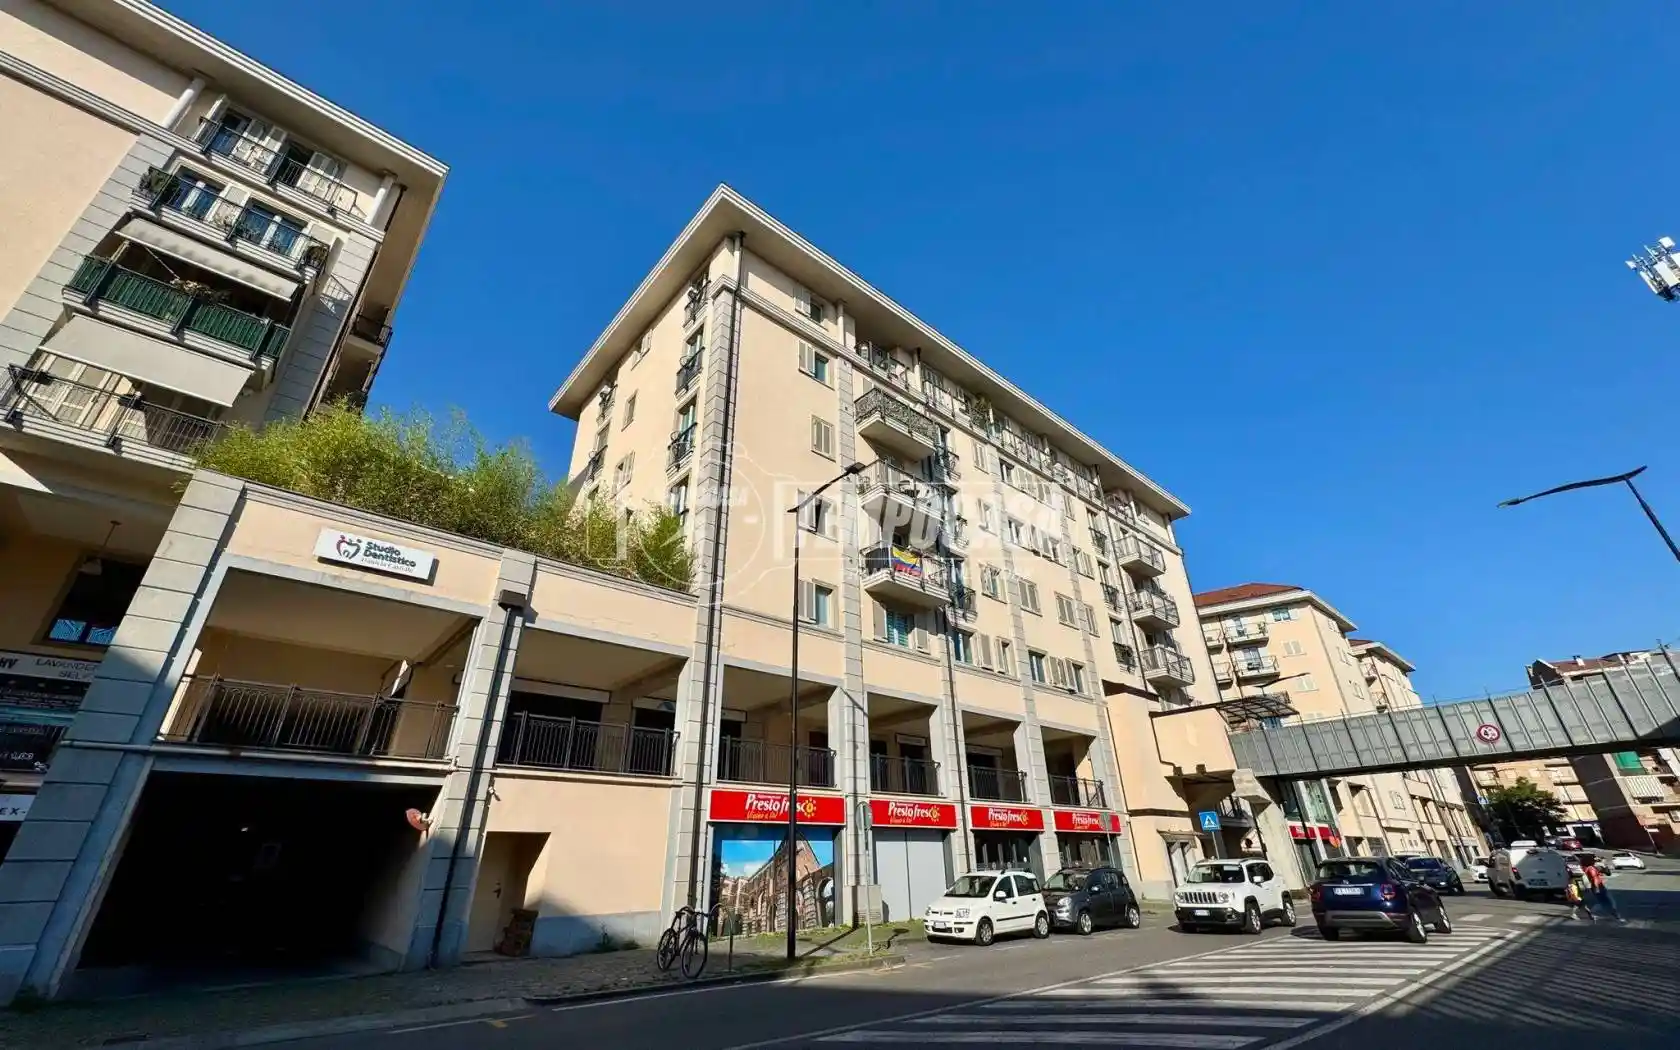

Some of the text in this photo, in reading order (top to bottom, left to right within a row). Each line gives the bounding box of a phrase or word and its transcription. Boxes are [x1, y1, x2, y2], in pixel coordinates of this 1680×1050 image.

[365, 541, 402, 556] Studio
[362, 549, 417, 568] Dentistico
[745, 793, 815, 817] Prestofrsco
[888, 801, 939, 821] Prestofresco
